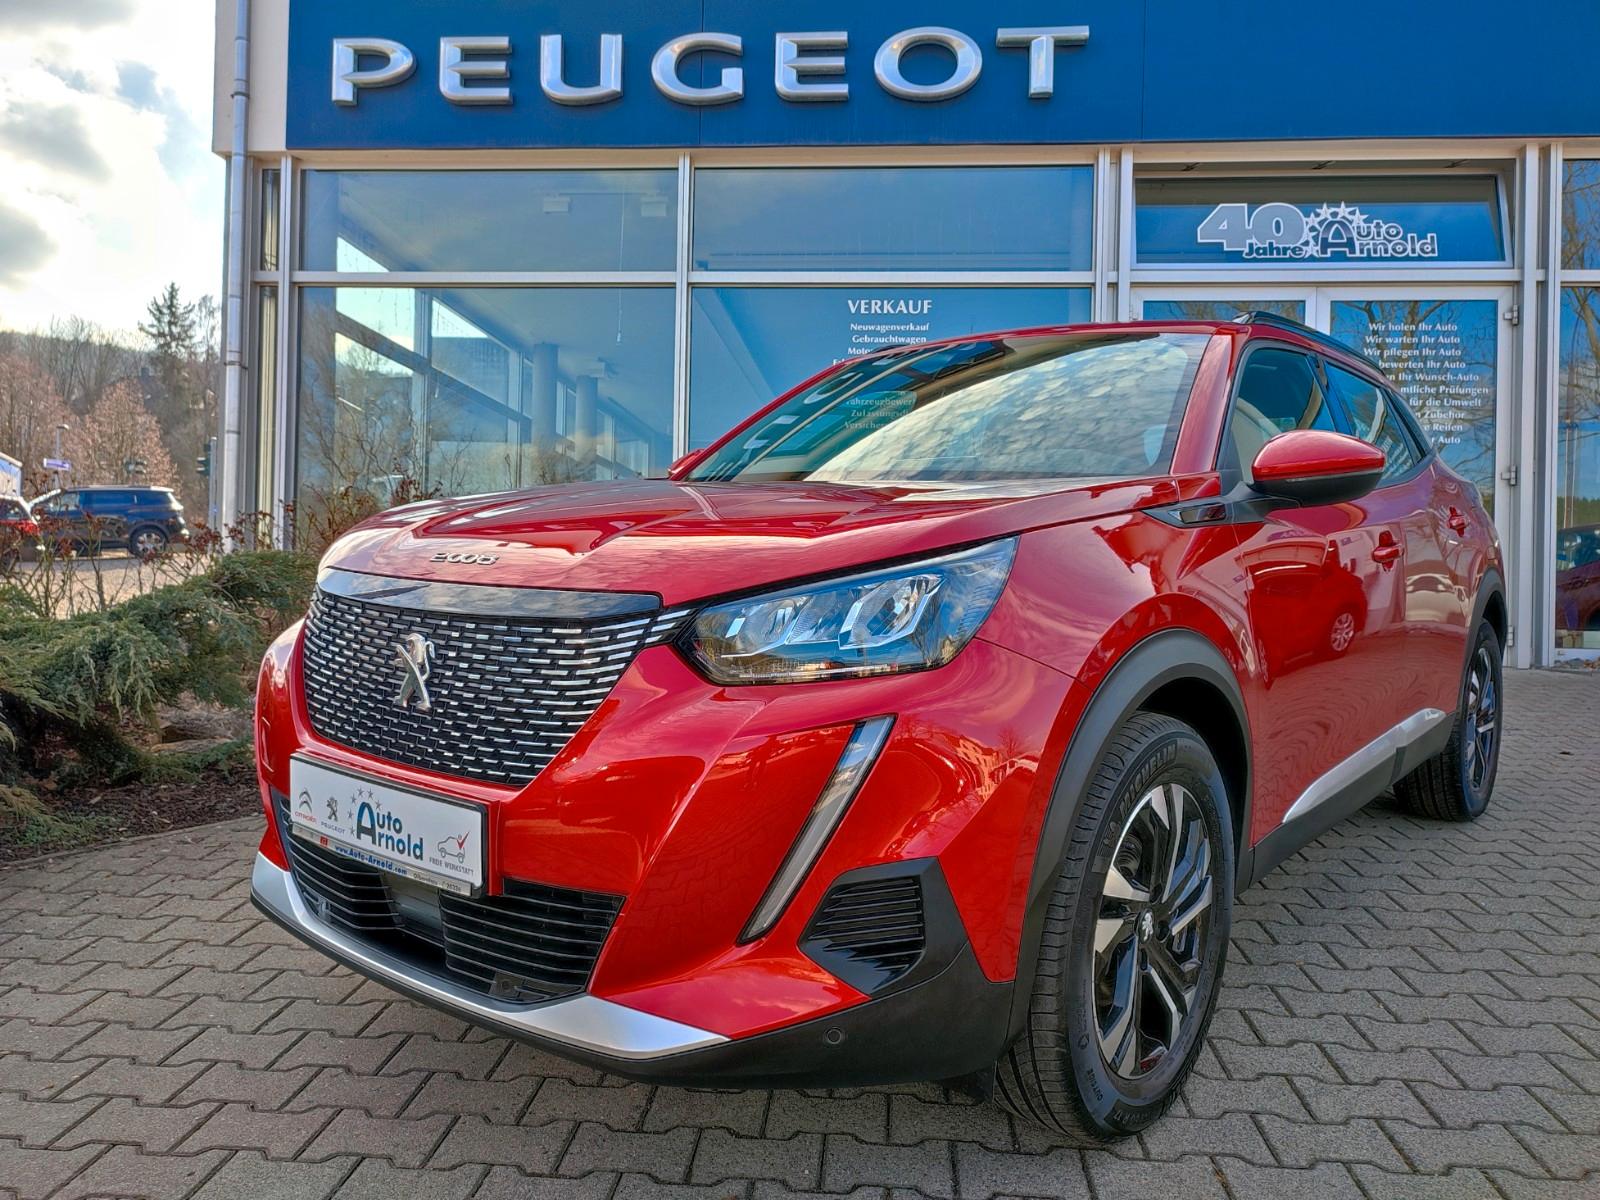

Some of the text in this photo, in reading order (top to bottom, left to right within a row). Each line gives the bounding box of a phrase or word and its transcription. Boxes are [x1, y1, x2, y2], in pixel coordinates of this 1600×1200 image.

[332, 26, 1090, 106] PEUGEOT
[1197, 202, 1306, 250] 40
[1319, 217, 1403, 257] Auto
[1319, 221, 1439, 258] Arnold
[1242, 240, 1305, 259] Jahre
[847, 299, 932, 314] VERKAUF
[850, 322, 930, 333] Neuwagenverkauf
[1368, 322, 1458, 331] Wir holen Ihr Auto
[851, 335, 927, 345] Gebrauchtwagen
[1365, 334, 1461, 344] Wir warten Ihr Auto
[1363, 347, 1462, 360] Wir pflegen Ihr Auto
[1378, 360, 1466, 369] bewerten Ihr Auto
[1398, 373, 1412, 381] Ihr
[1415, 372, 1479, 381] Wunsch-Auto
[1400, 384, 1489, 397] mtliche Prüfungen
[1409, 397, 1482, 407] für die Umwelt
[1432, 423, 1463, 432] Reifen
[1438, 436, 1461, 444] Auto
[320, 821, 346, 836] PEUGEOT
[335, 845, 408, 875] www.Auto-Arnold.com
